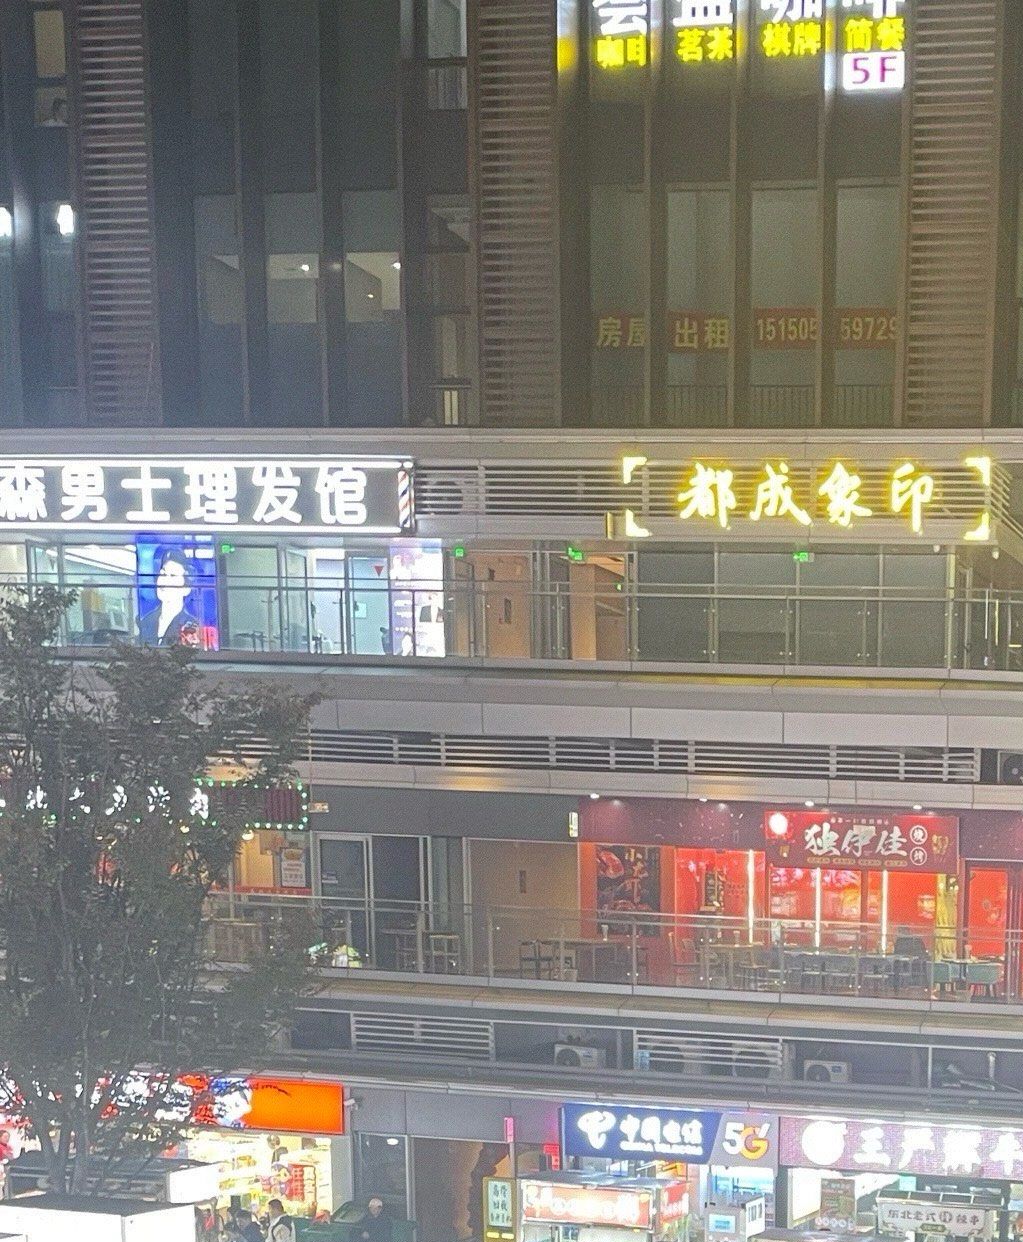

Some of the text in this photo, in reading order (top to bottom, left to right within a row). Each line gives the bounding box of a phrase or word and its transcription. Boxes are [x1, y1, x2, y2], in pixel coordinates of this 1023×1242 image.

[763, 22, 821, 56] 棋牌
[845, 18, 905, 52] 简餐
[853, 56, 897, 84] 5F
[674, 316, 730, 349] 出租
